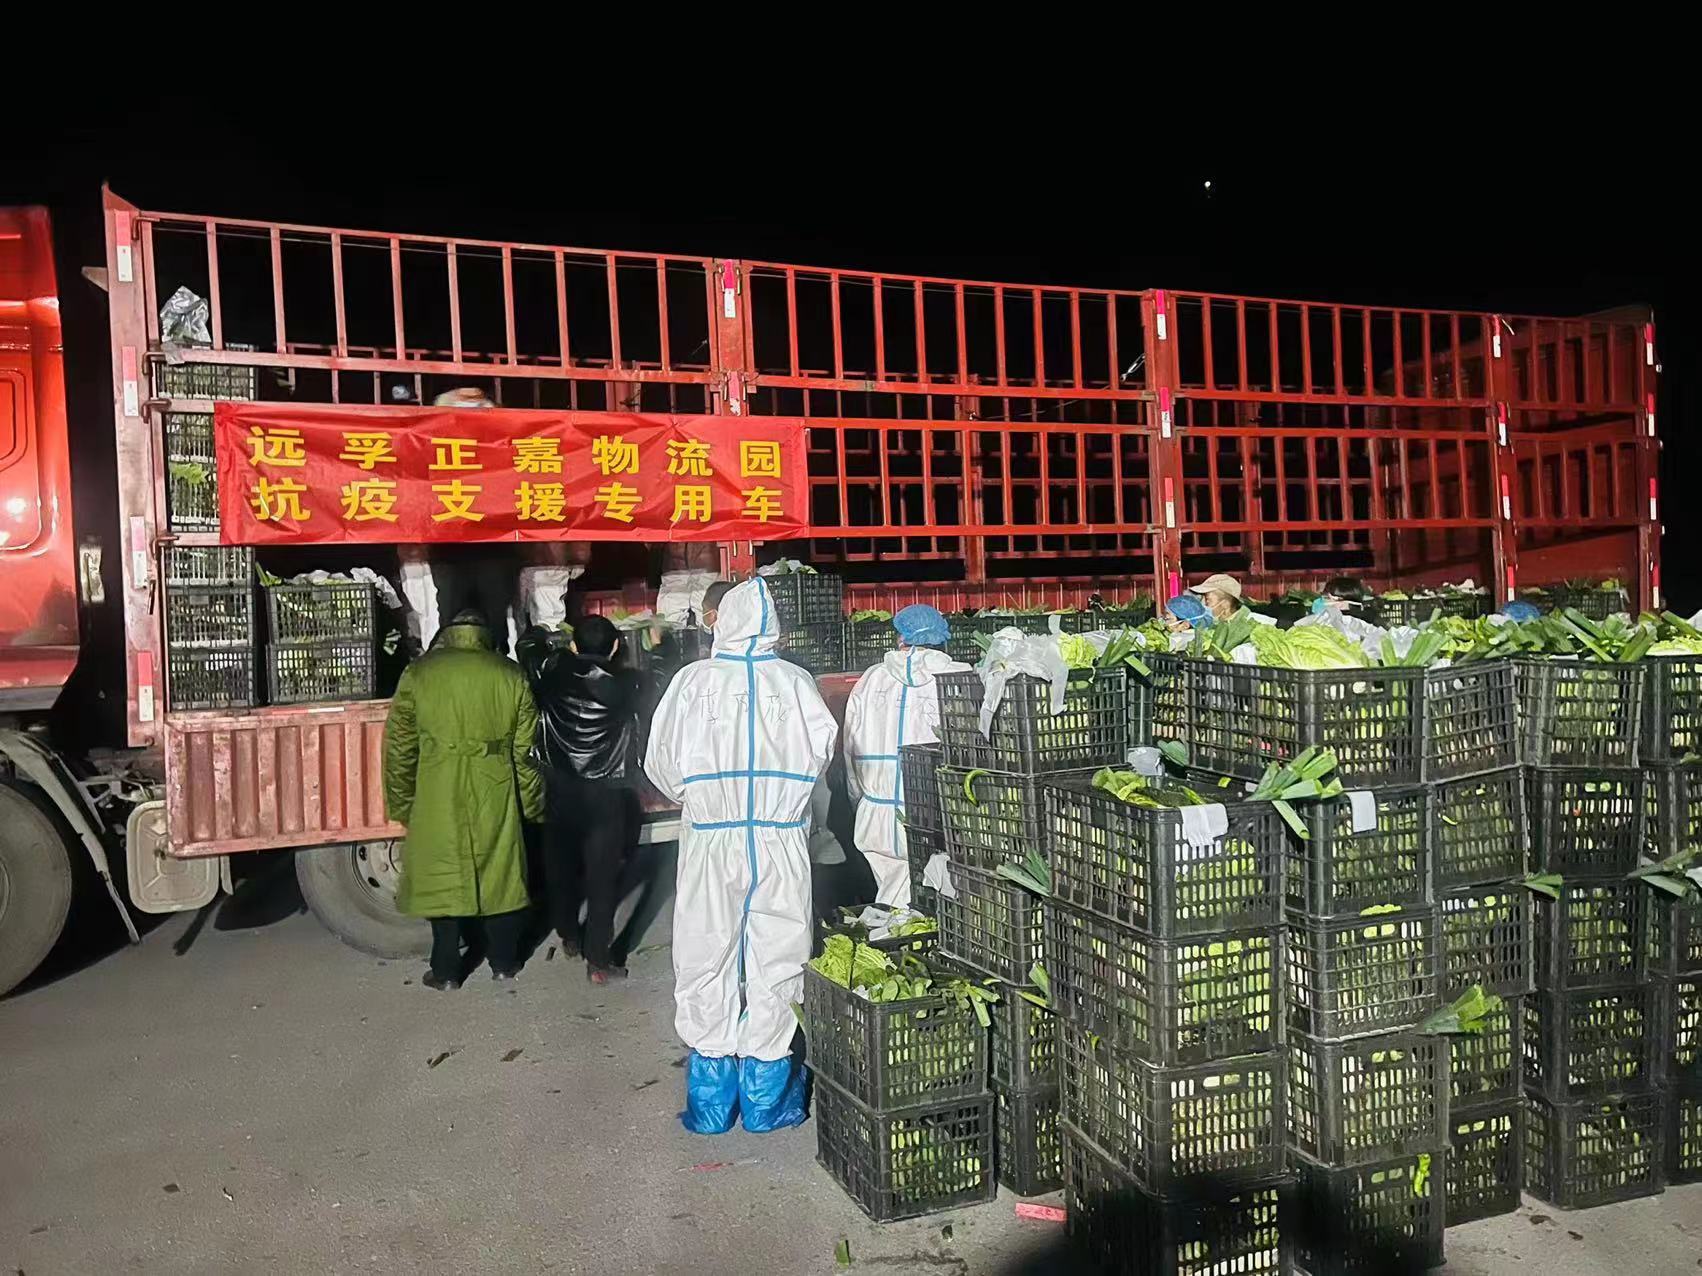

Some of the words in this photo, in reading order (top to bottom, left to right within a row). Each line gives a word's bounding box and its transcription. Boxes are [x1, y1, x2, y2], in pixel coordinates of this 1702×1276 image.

[246, 425, 782, 479] 远孚正嘉物流园
[250, 476, 785, 524] 抗疫支援专用车
